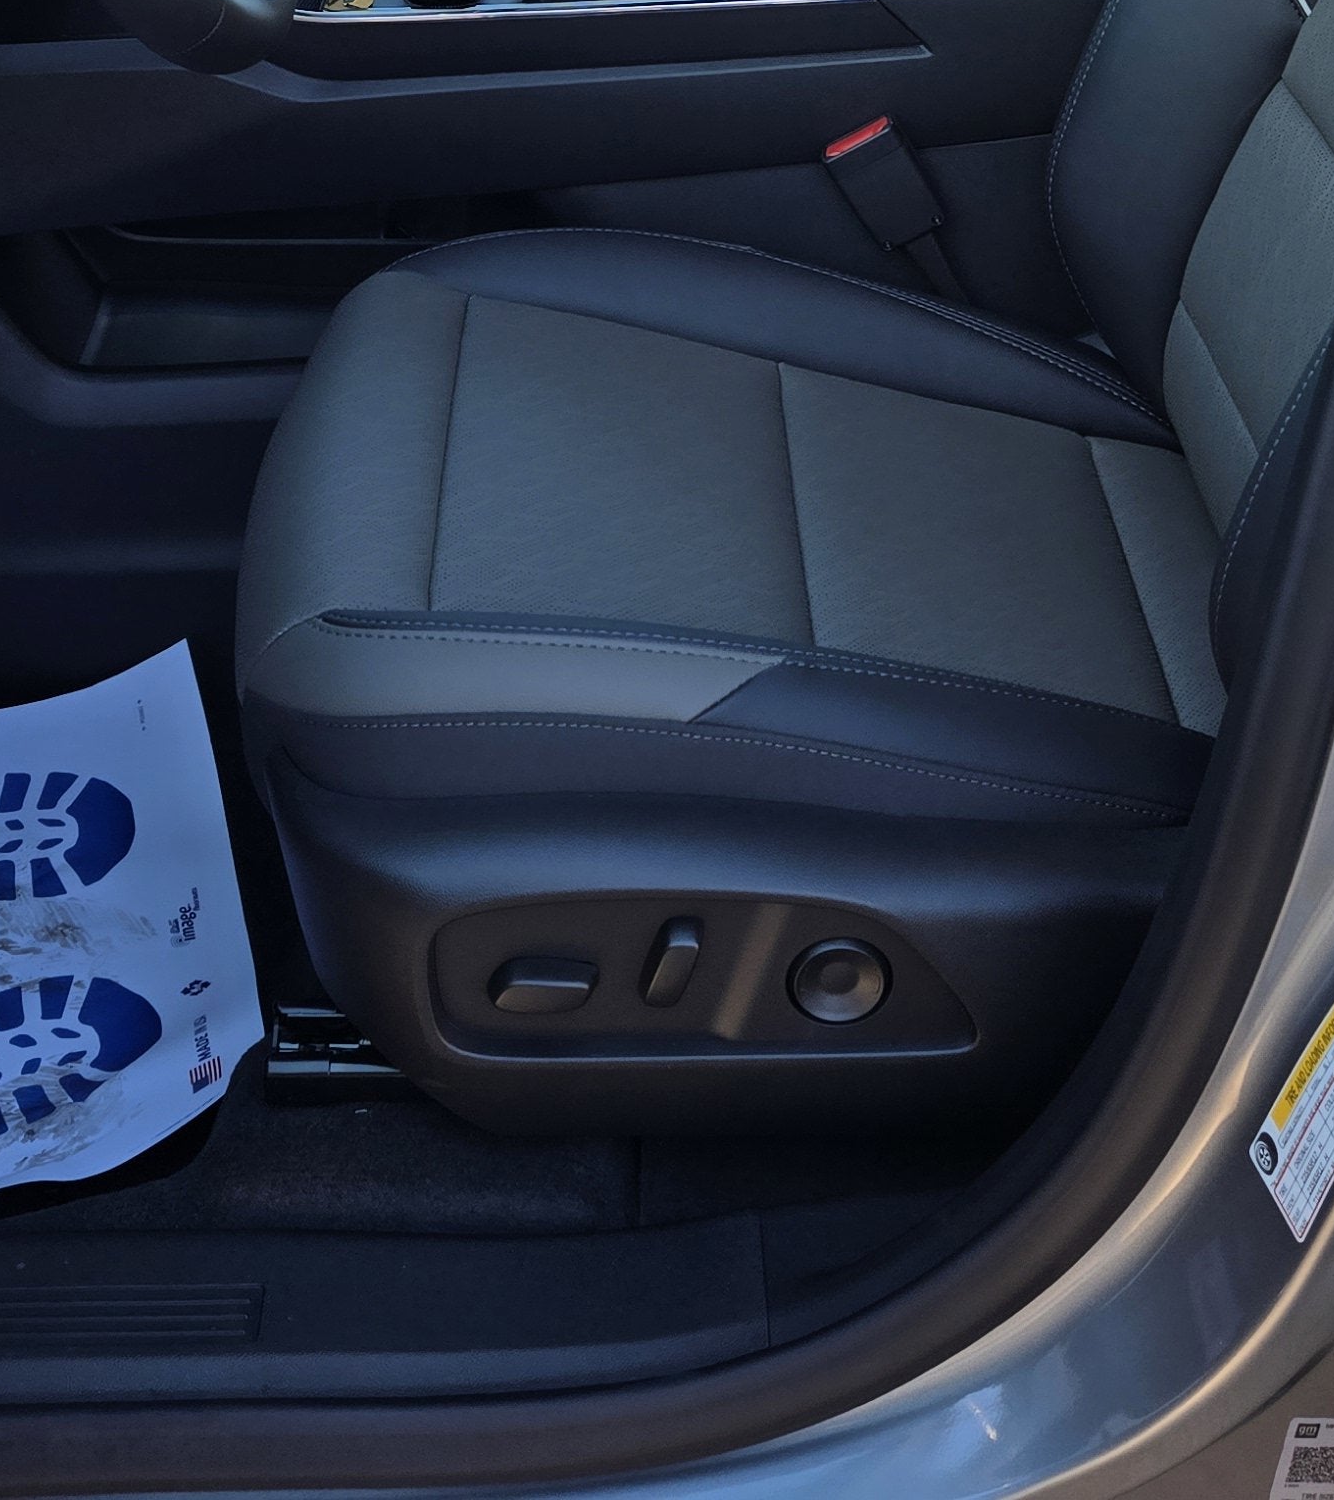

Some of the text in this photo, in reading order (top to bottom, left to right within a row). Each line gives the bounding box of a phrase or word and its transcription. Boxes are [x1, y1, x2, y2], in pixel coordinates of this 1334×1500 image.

[178, 903, 197, 942] image
[194, 1032, 212, 1062] MADE
[1284, 1083, 1299, 1108] TIRE
[1293, 1068, 1307, 1092] AND
[1302, 1038, 1325, 1077] LOADING
[1297, 1425, 1319, 1437] gm
